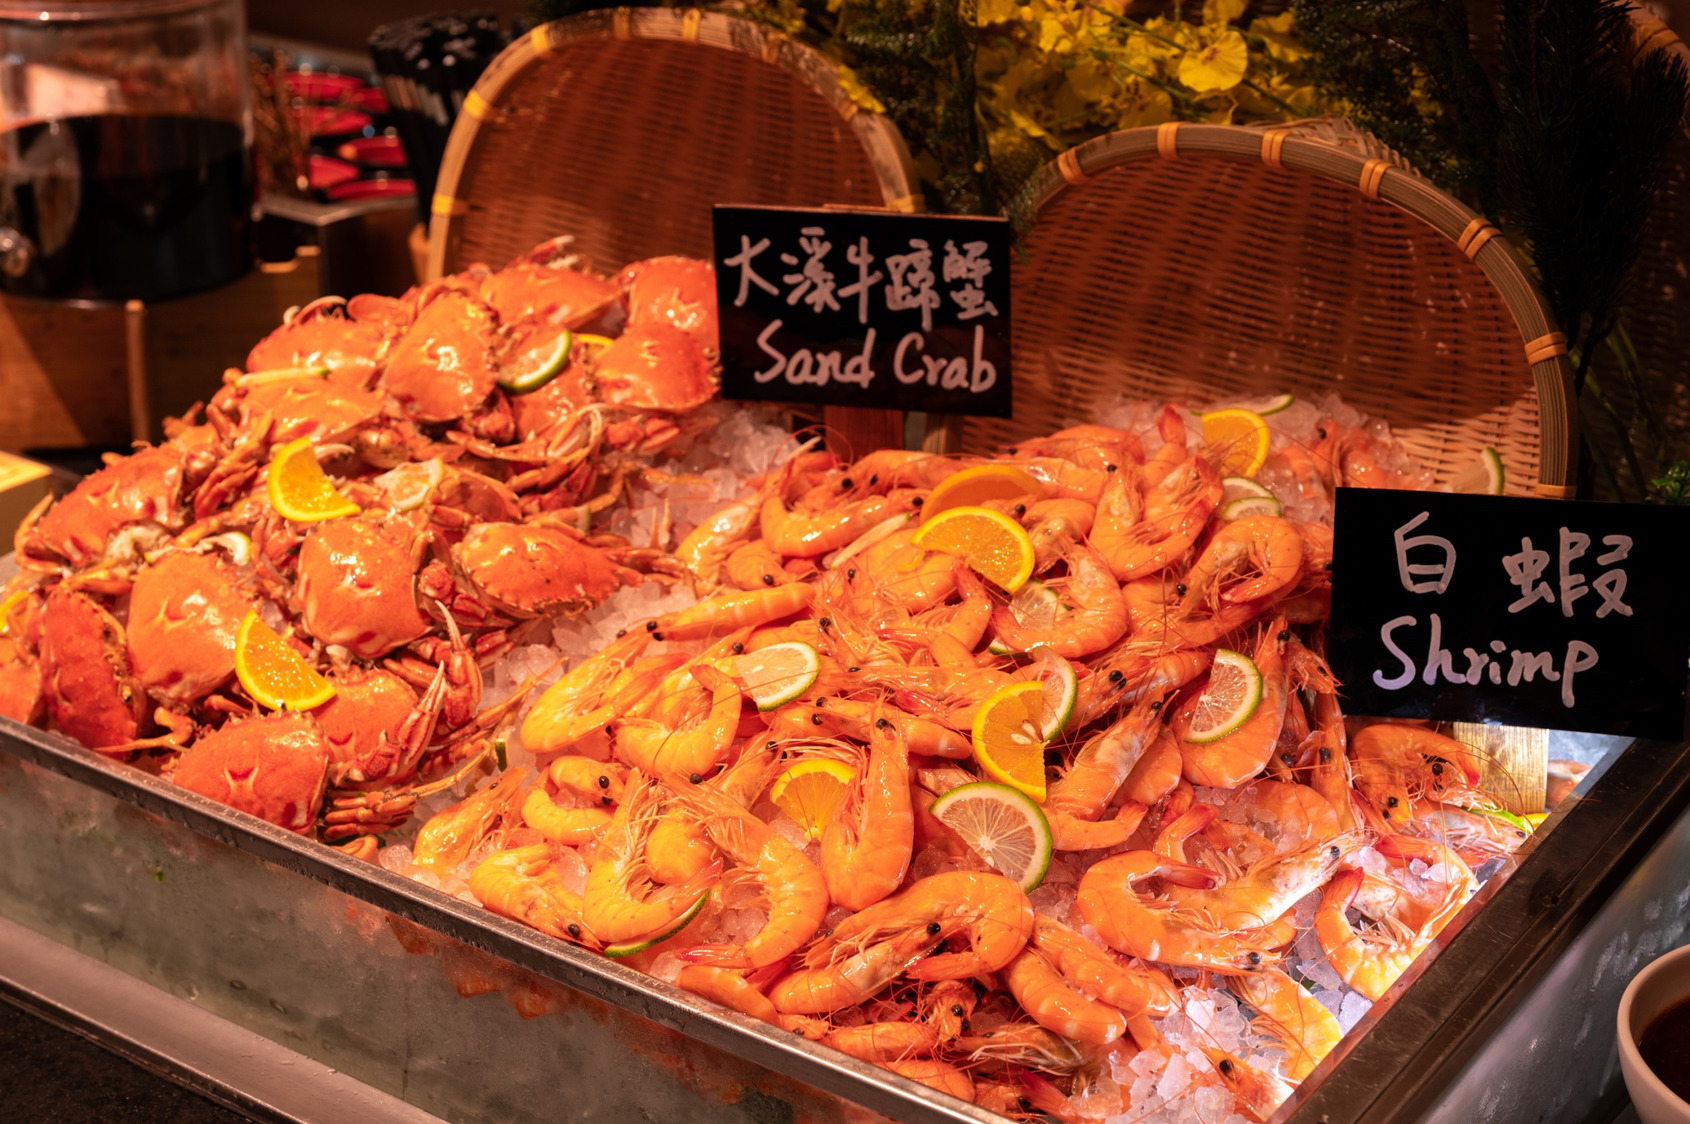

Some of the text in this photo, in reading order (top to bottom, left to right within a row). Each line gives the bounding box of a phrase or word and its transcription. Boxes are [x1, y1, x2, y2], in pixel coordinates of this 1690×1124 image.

[754, 319, 996, 393] Sand Crab
[1372, 613, 1599, 708] Shrimp
